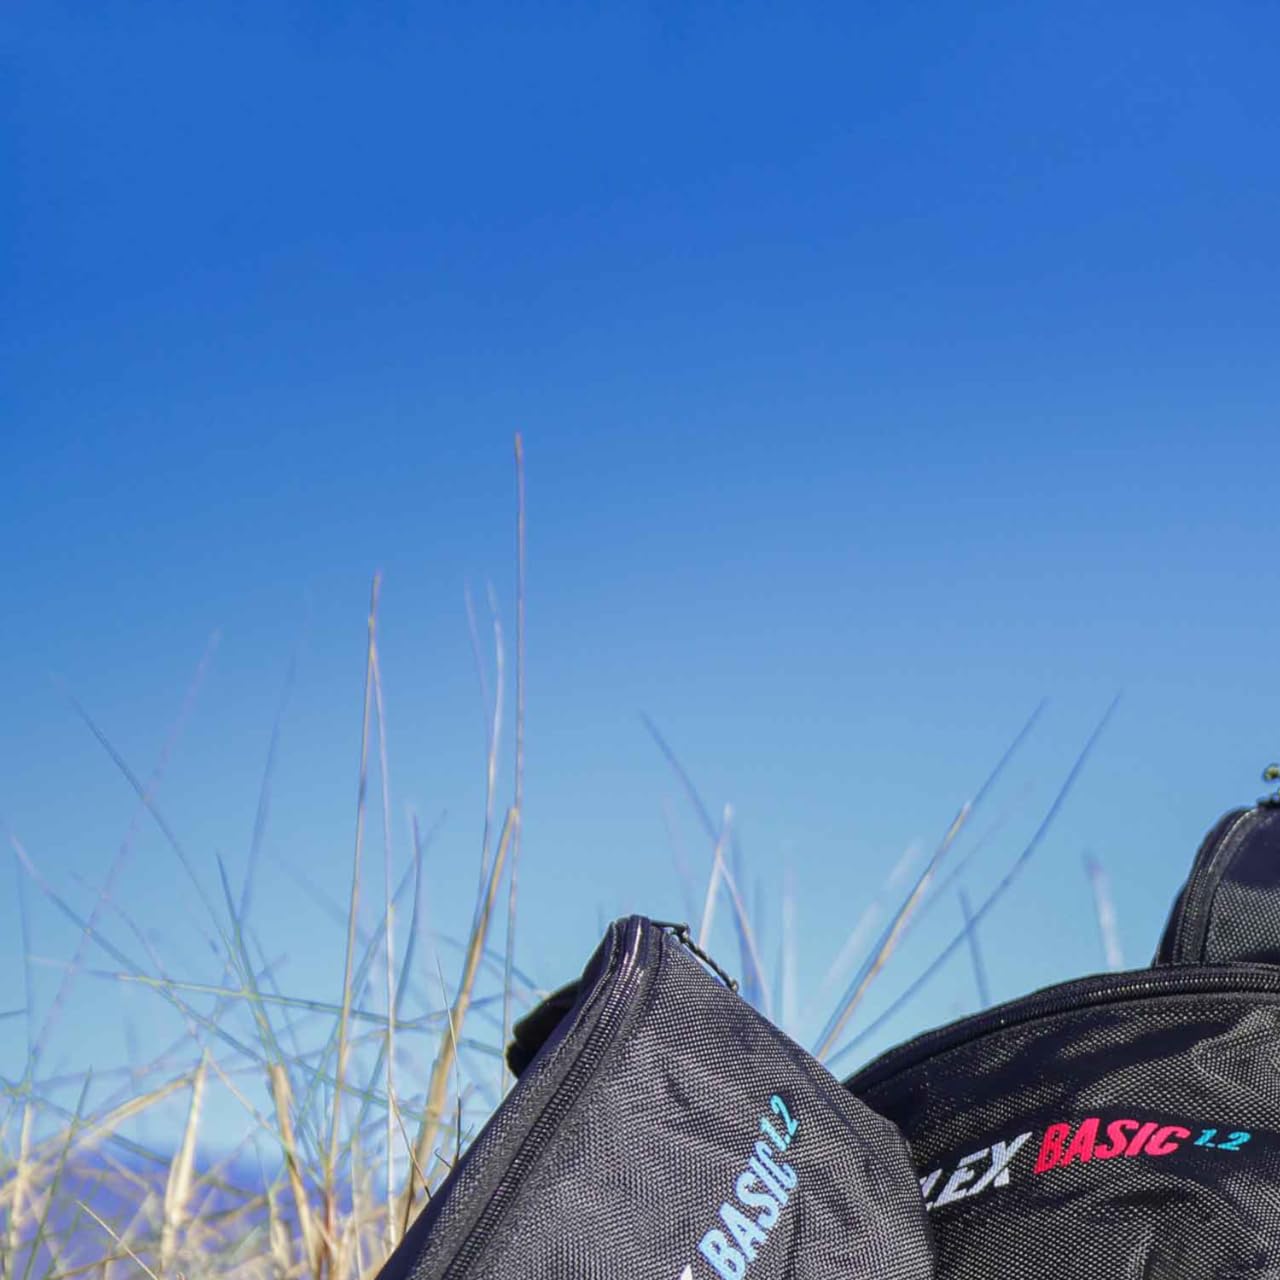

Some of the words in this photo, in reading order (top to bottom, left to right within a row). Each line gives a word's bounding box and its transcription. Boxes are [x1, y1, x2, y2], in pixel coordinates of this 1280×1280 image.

[760, 1095, 799, 1151] 1.2
[1034, 1118, 1190, 1175] BASIC
[1193, 1128, 1250, 1151] 1.2
